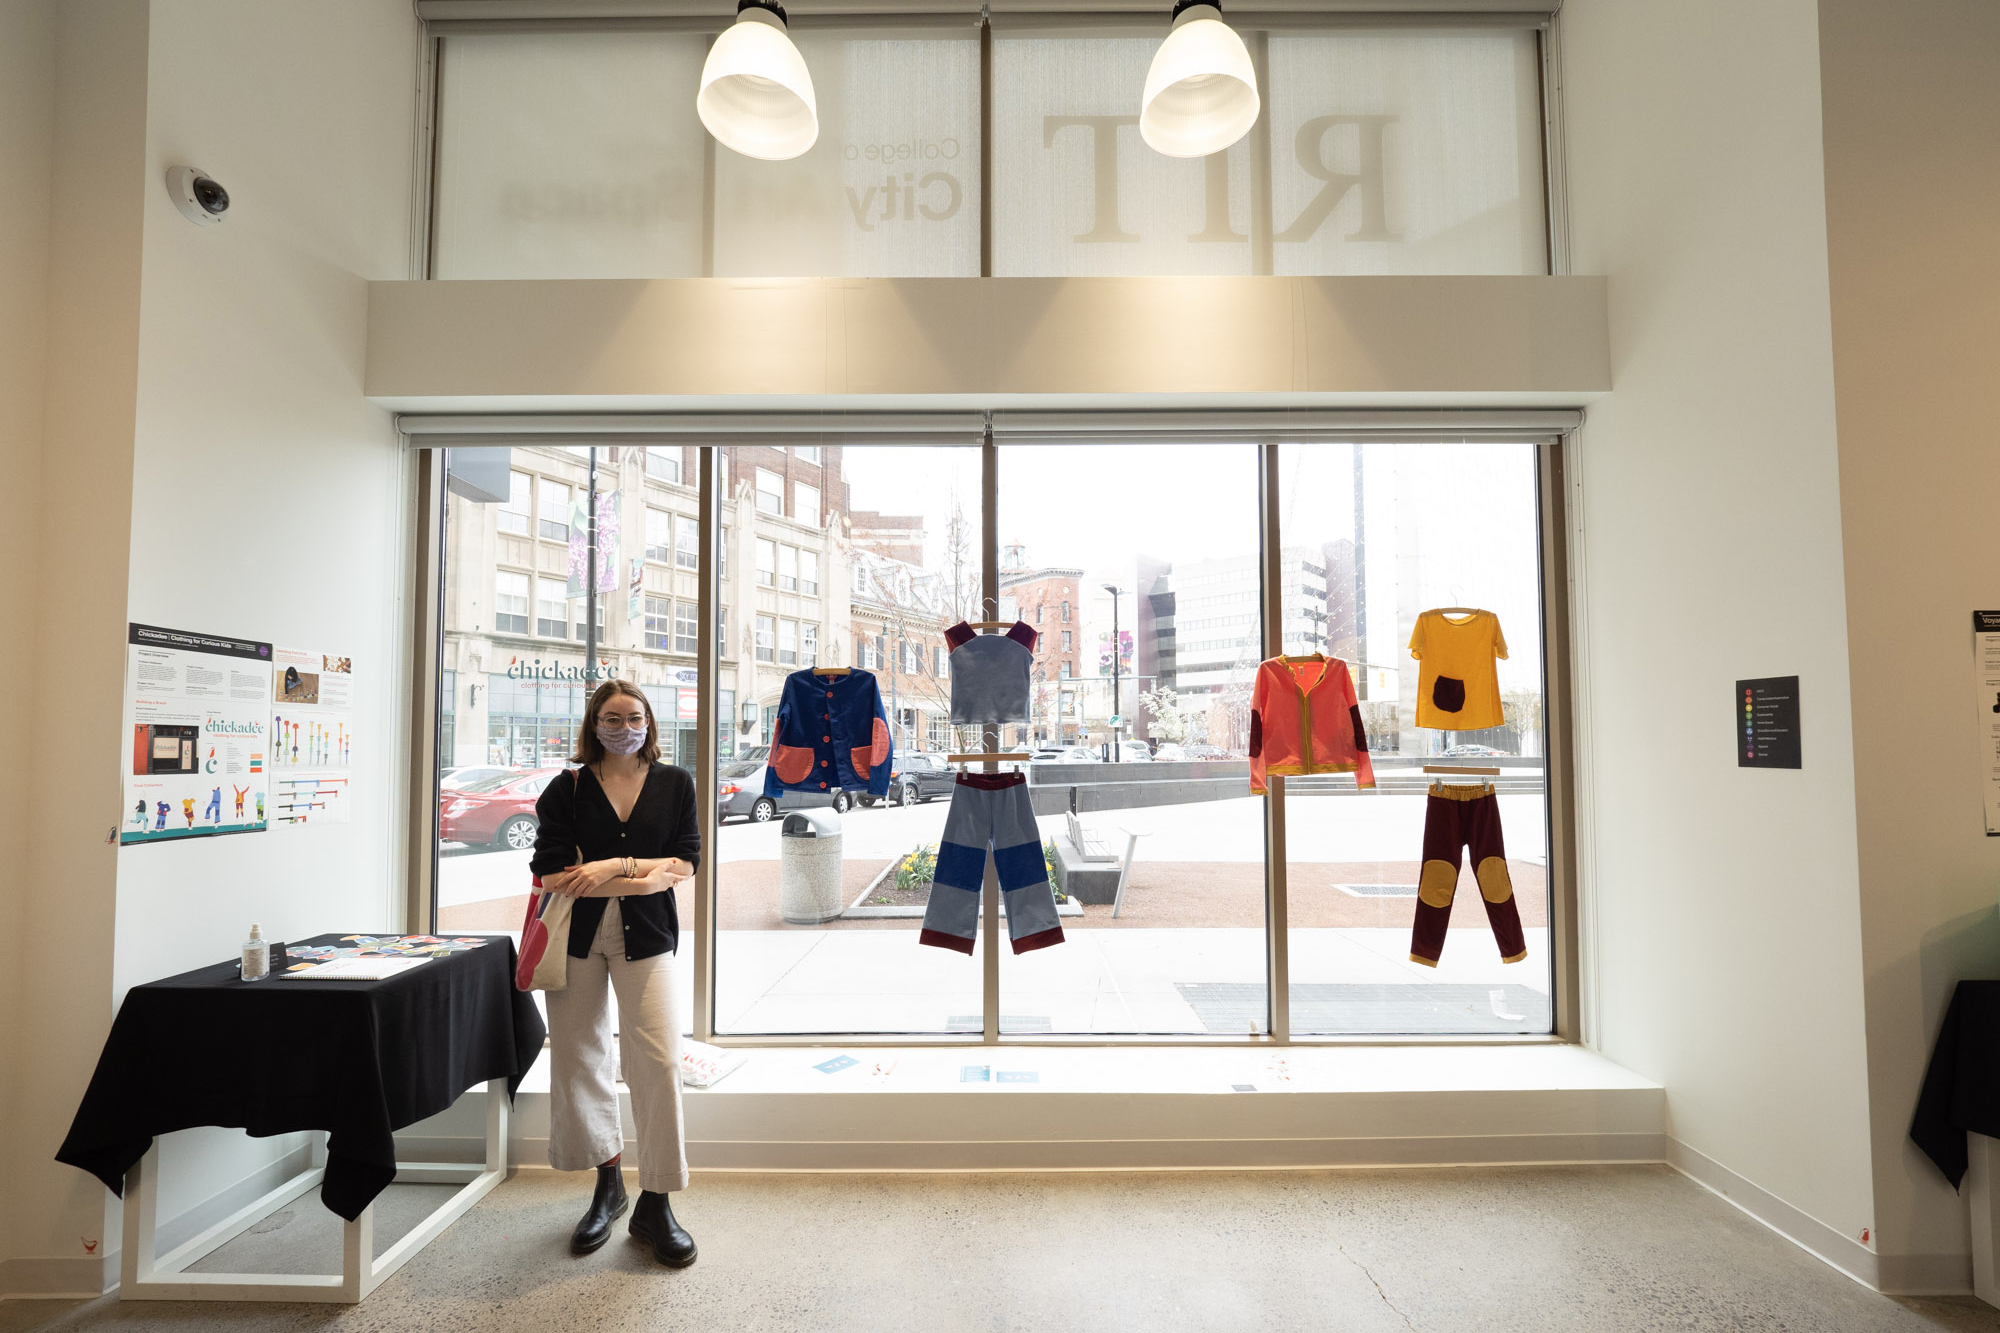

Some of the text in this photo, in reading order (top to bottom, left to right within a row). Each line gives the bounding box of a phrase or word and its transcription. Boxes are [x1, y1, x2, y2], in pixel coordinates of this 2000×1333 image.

[507, 658, 619, 680] chickadee
[520, 682, 549, 690] clothing
[205, 719, 264, 734] chickadee
